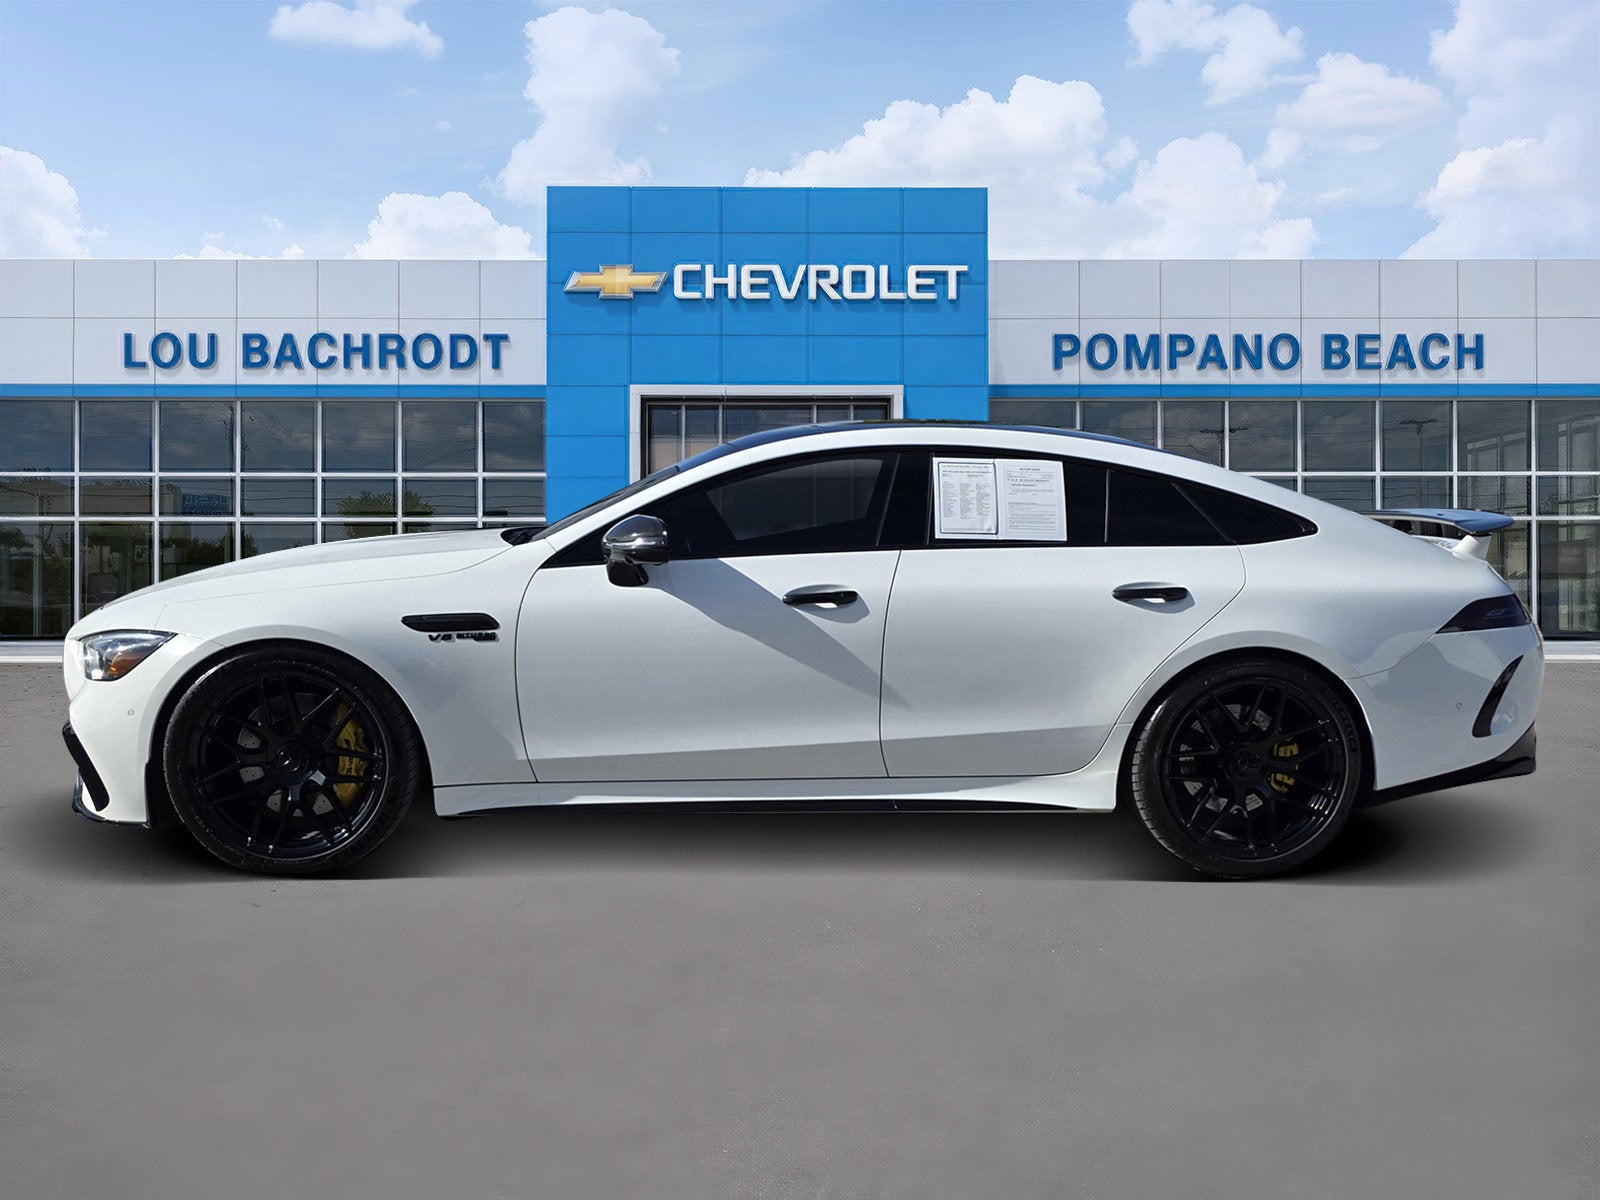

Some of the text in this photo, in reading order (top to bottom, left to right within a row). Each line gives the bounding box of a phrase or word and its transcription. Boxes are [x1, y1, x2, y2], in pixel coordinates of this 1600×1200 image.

[673, 264, 968, 300] CHEVROLET
[123, 332, 510, 370] LOU BACHRODT
[1052, 332, 1485, 370] POMPANO BEACH
